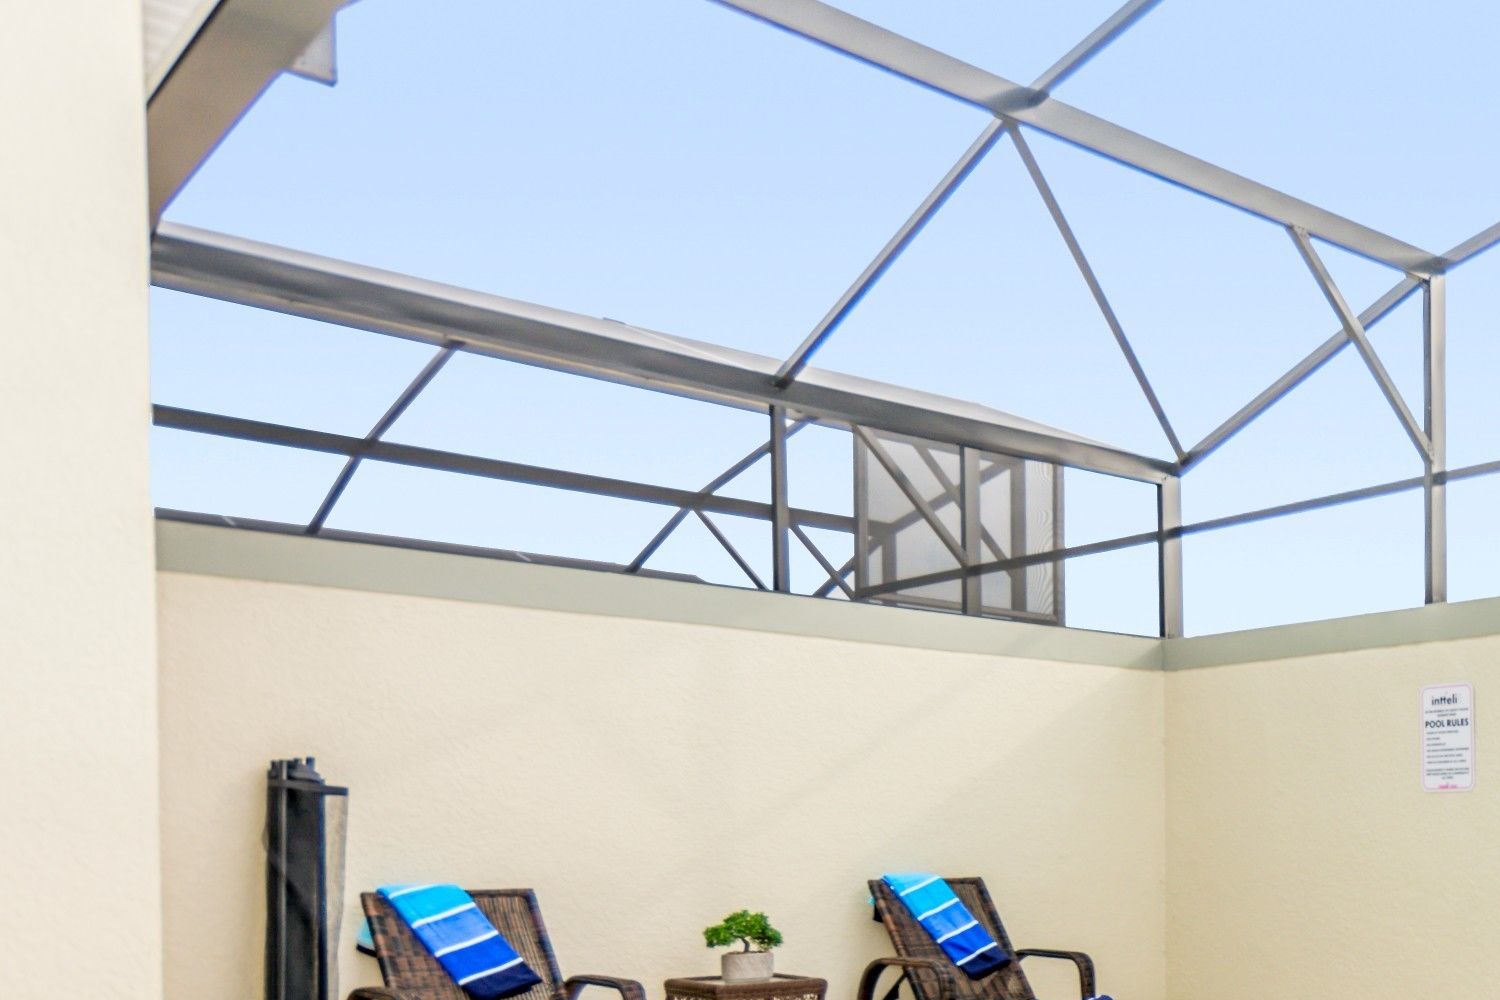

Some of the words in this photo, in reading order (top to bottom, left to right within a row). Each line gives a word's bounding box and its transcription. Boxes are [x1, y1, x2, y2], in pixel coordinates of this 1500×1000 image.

[1432, 694, 1457, 705] intteli
[1425, 720, 1445, 728] POOL
[1447, 718, 1469, 727] RULES
